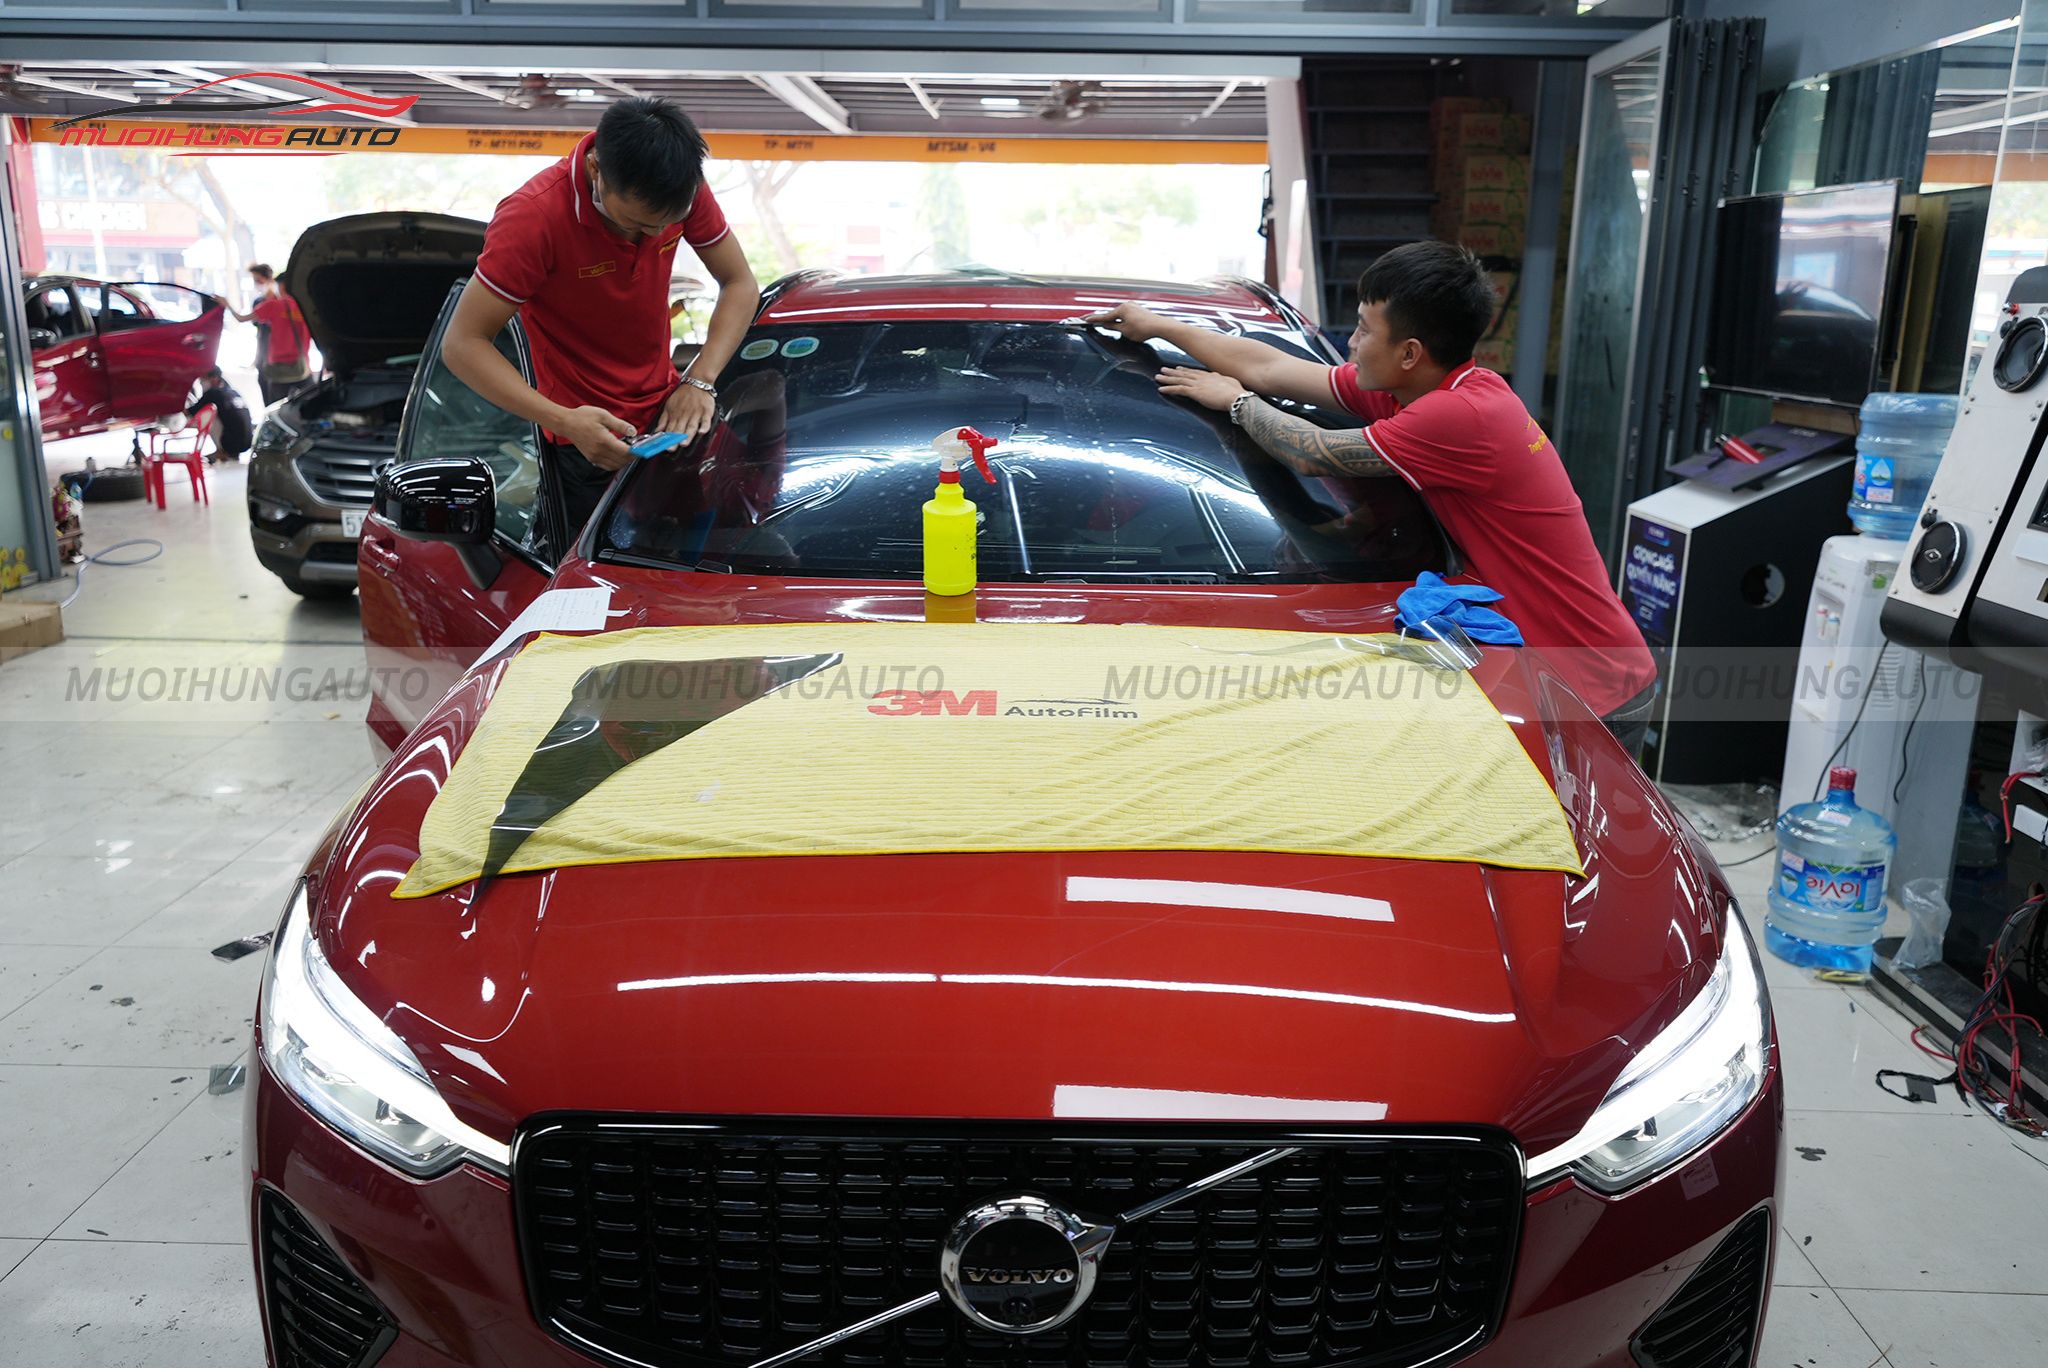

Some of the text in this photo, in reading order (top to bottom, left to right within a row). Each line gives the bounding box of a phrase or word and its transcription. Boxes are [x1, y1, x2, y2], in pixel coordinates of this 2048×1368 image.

[867, 689, 1138, 719] 3M AutoFilm
[1806, 876, 1861, 899] laVie
[962, 1267, 1075, 1284] VOLVO
